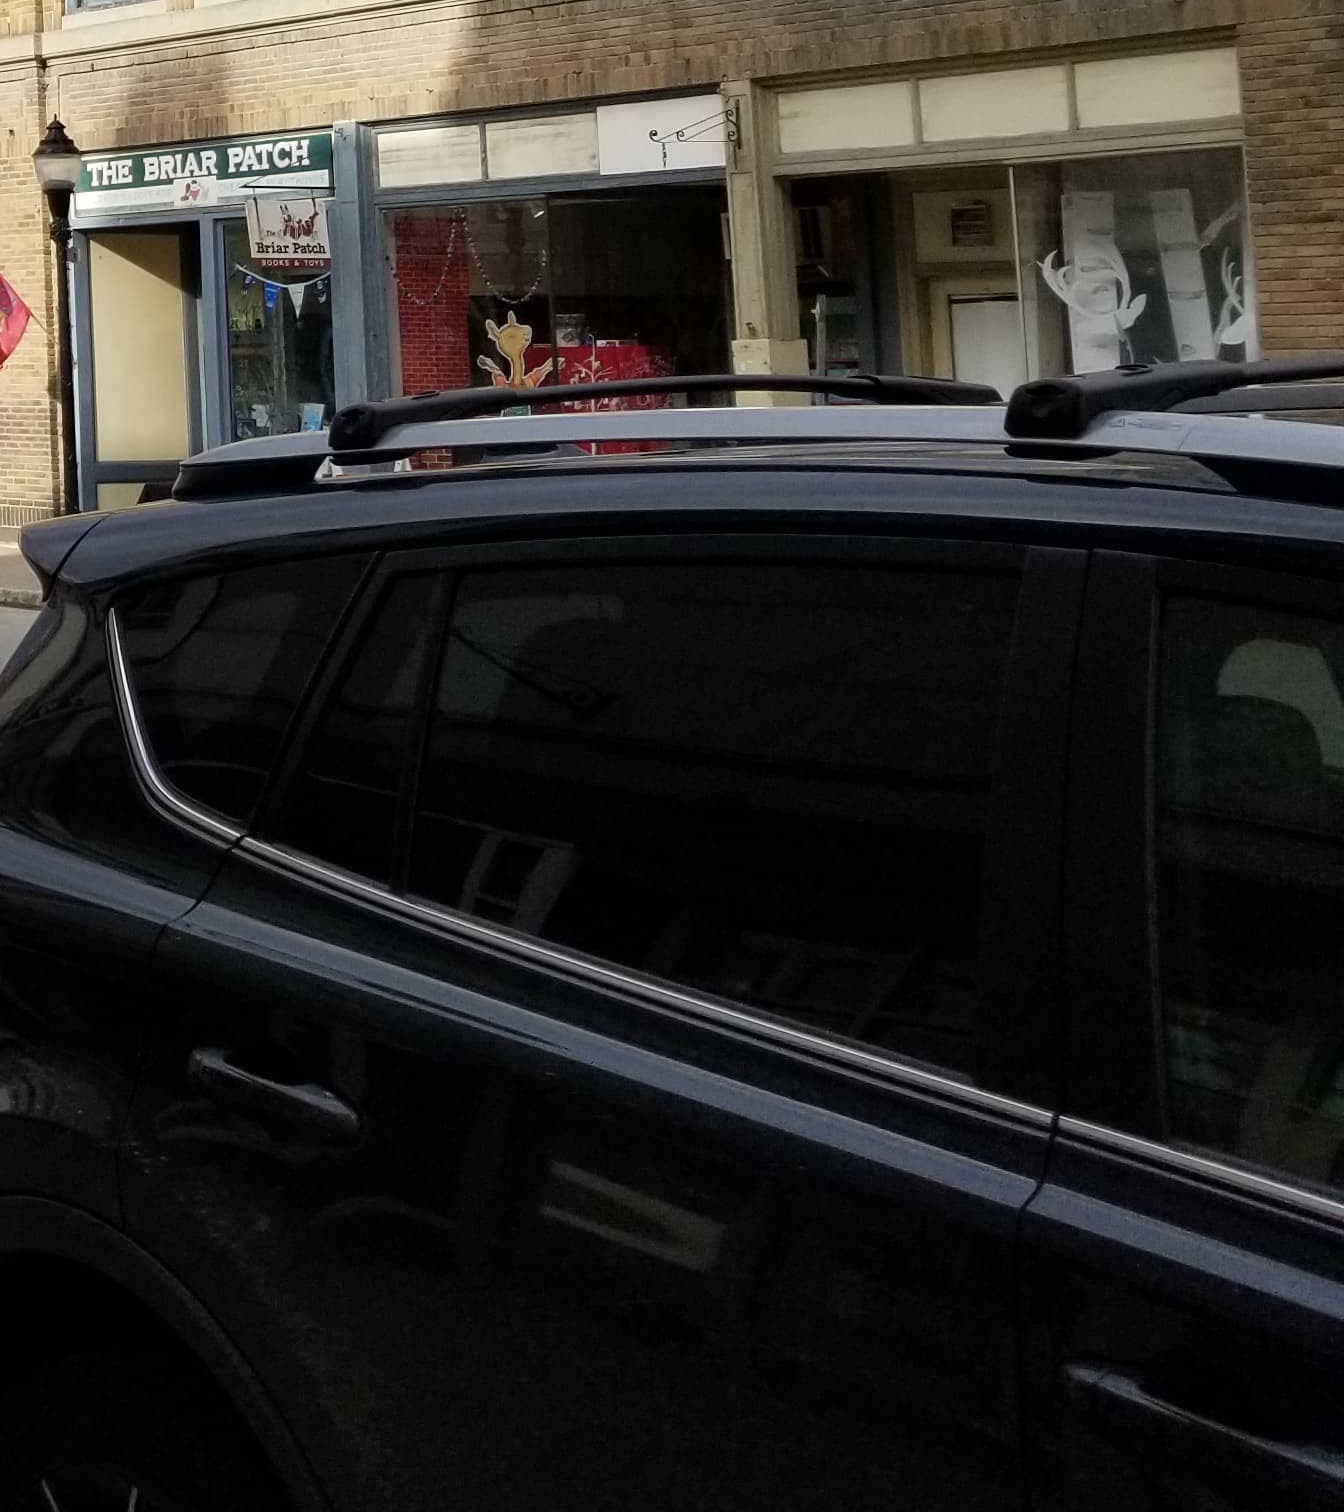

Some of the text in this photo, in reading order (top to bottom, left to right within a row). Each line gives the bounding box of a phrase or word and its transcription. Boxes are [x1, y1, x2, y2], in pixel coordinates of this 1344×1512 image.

[86, 139, 310, 187] THE BRIAR PATCH
[255, 242, 327, 254] Briar Patch
[261, 259, 325, 267] BOOKS & TOYS
